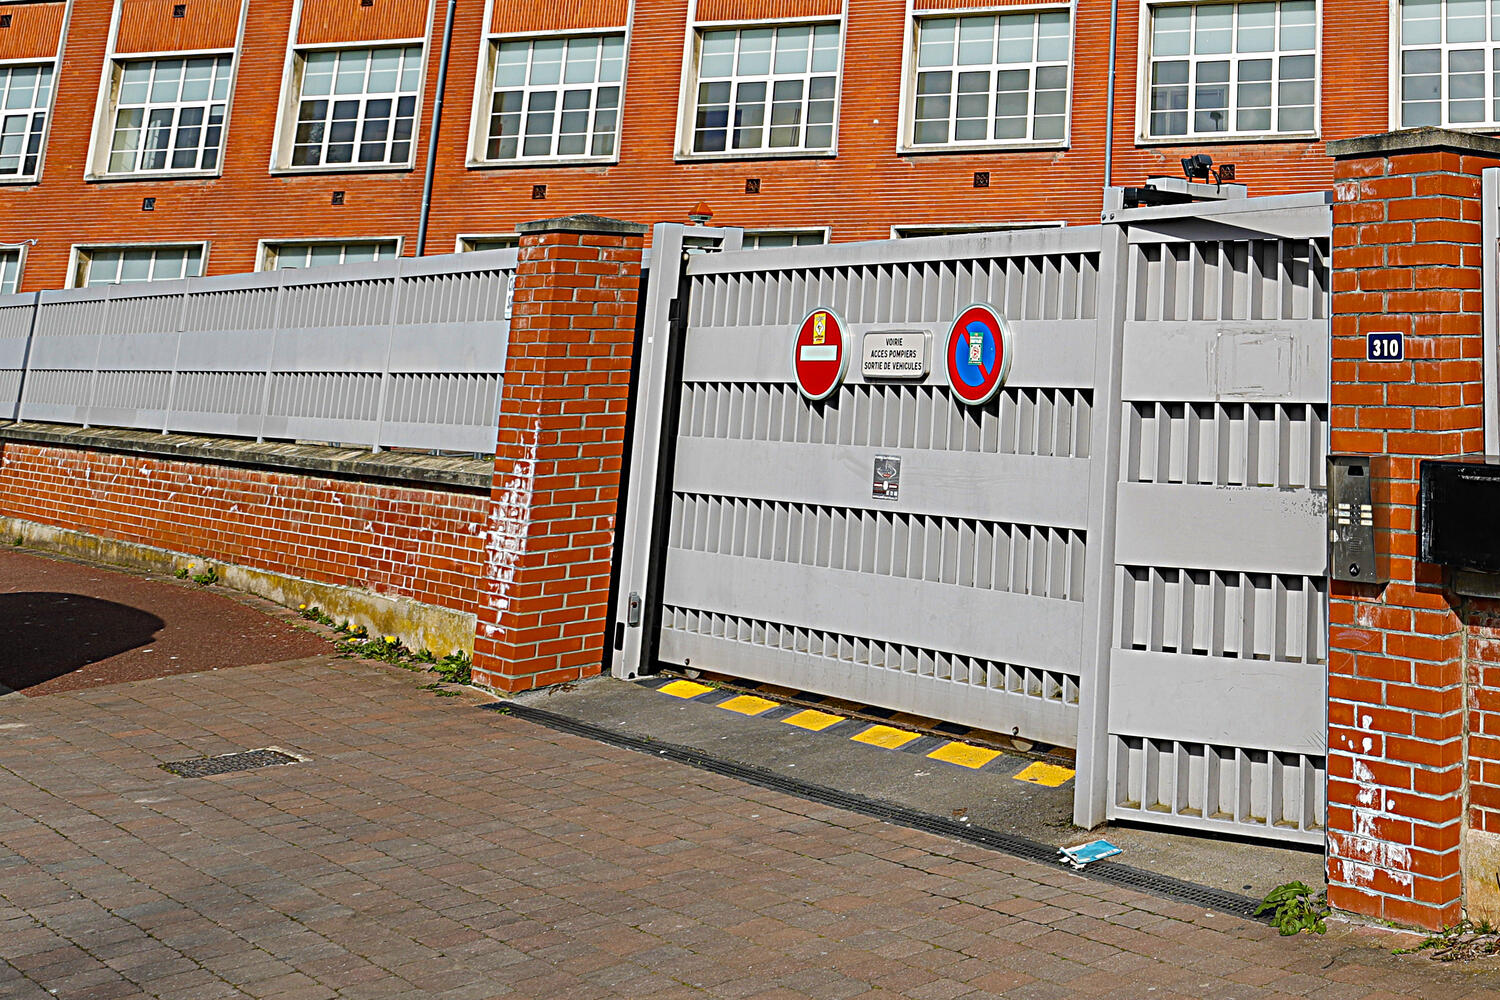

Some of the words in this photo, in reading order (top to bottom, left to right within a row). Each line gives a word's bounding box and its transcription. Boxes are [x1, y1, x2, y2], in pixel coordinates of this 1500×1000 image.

[886, 338, 903, 346] VOIRIE
[1373, 339, 1398, 356] 310
[889, 350, 916, 358] POMPIERS
[864, 362, 882, 370] SORTIE
[884, 362, 891, 370] DE
